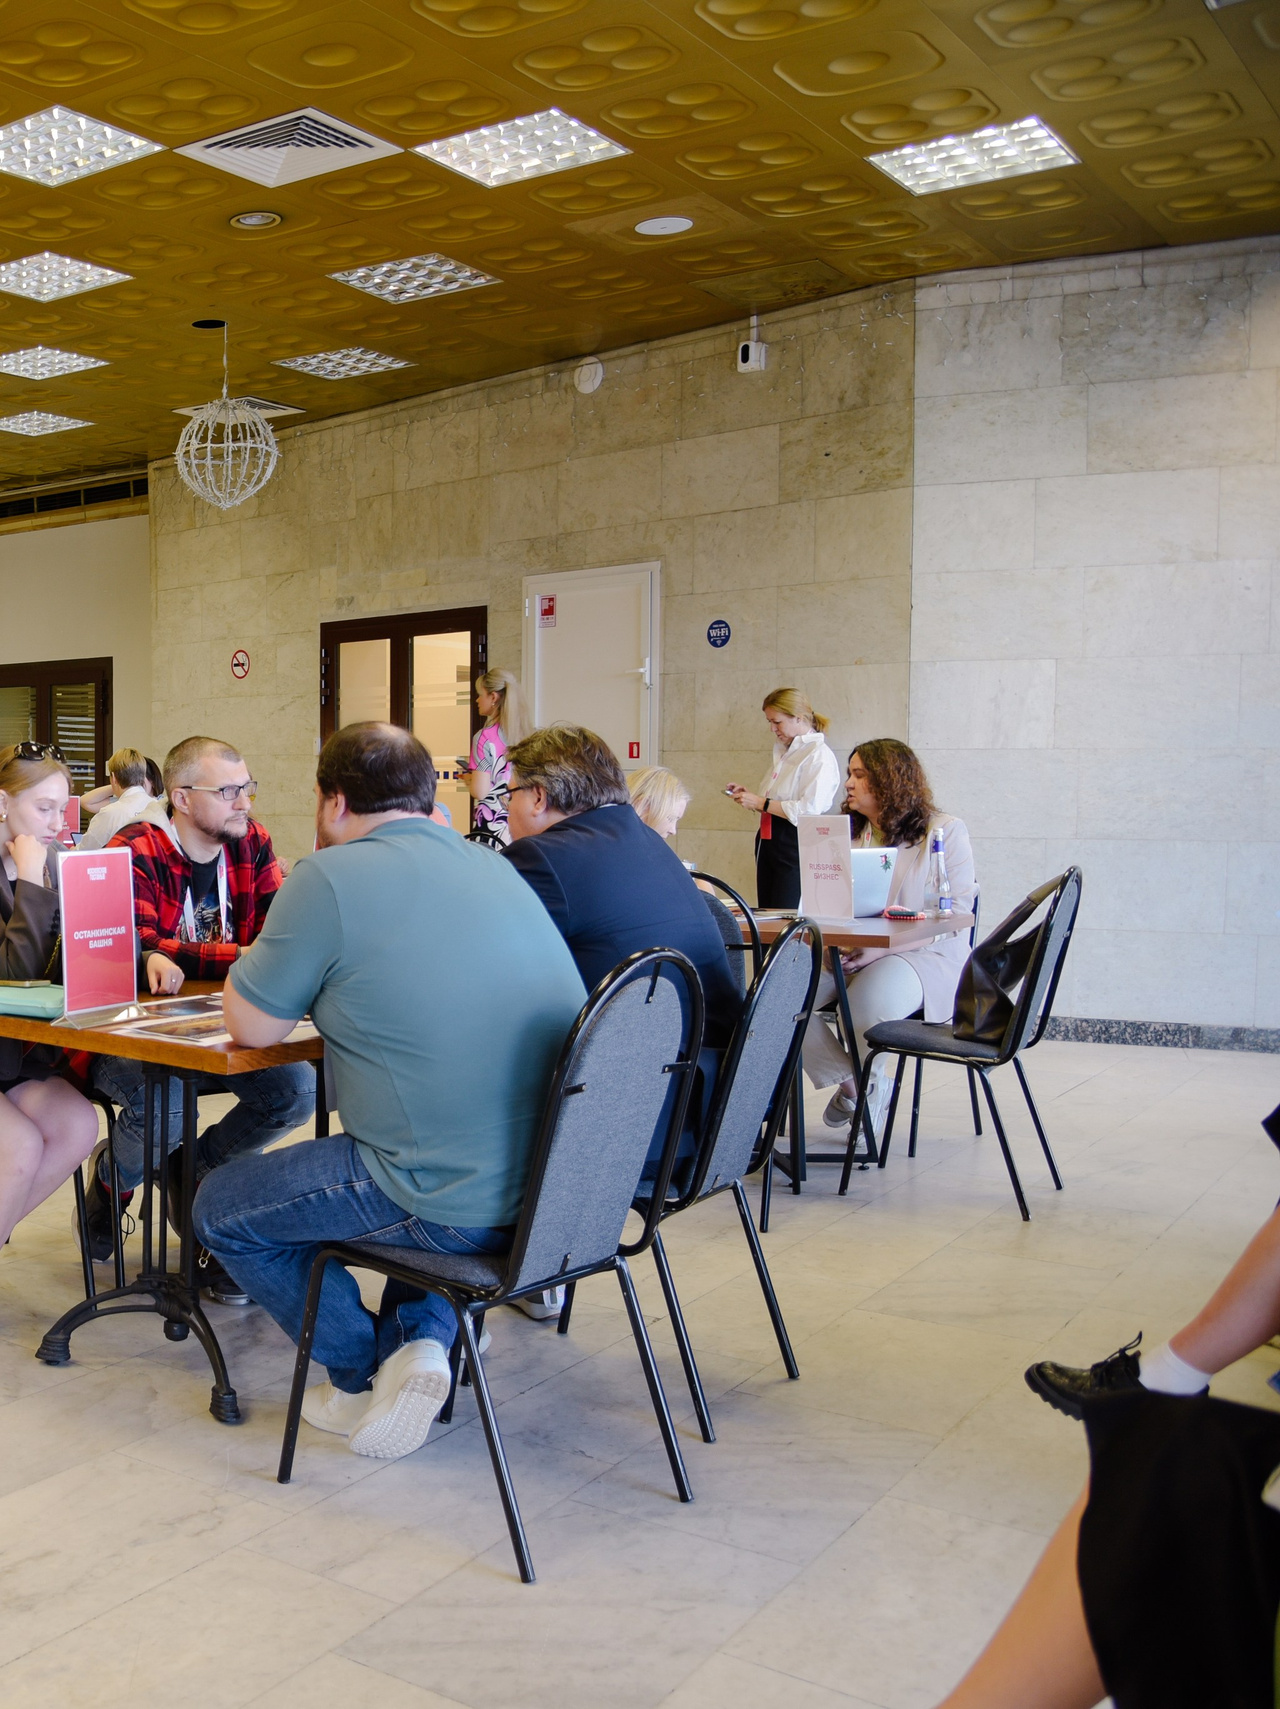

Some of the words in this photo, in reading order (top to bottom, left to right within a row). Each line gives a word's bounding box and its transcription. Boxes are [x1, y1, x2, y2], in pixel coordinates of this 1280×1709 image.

[709, 627, 729, 637] Wi-Fi
[814, 872, 840, 880] БИЗНЕС
[73, 926, 126, 940] ОСТАНКИНСКАЯ
[88, 938, 113, 949] БАШНЯ
